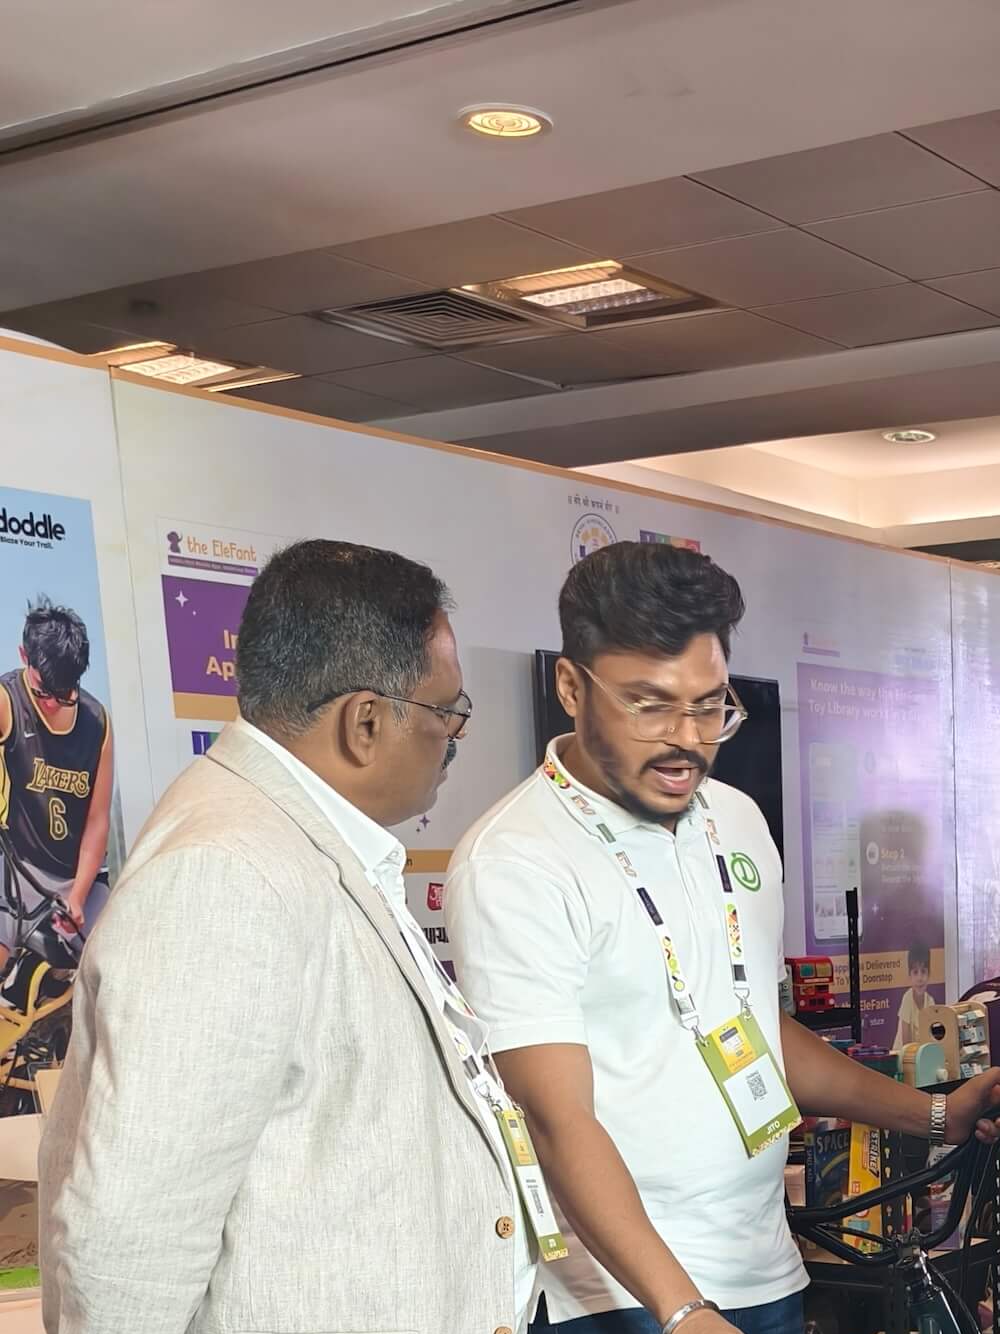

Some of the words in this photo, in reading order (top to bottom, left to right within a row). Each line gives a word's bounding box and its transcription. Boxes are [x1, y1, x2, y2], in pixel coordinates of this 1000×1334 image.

[187, 536, 208, 556] the
[212, 539, 257, 562] EleFant
[25, 757, 90, 798] LAKERS
[48, 796, 68, 841] 6
